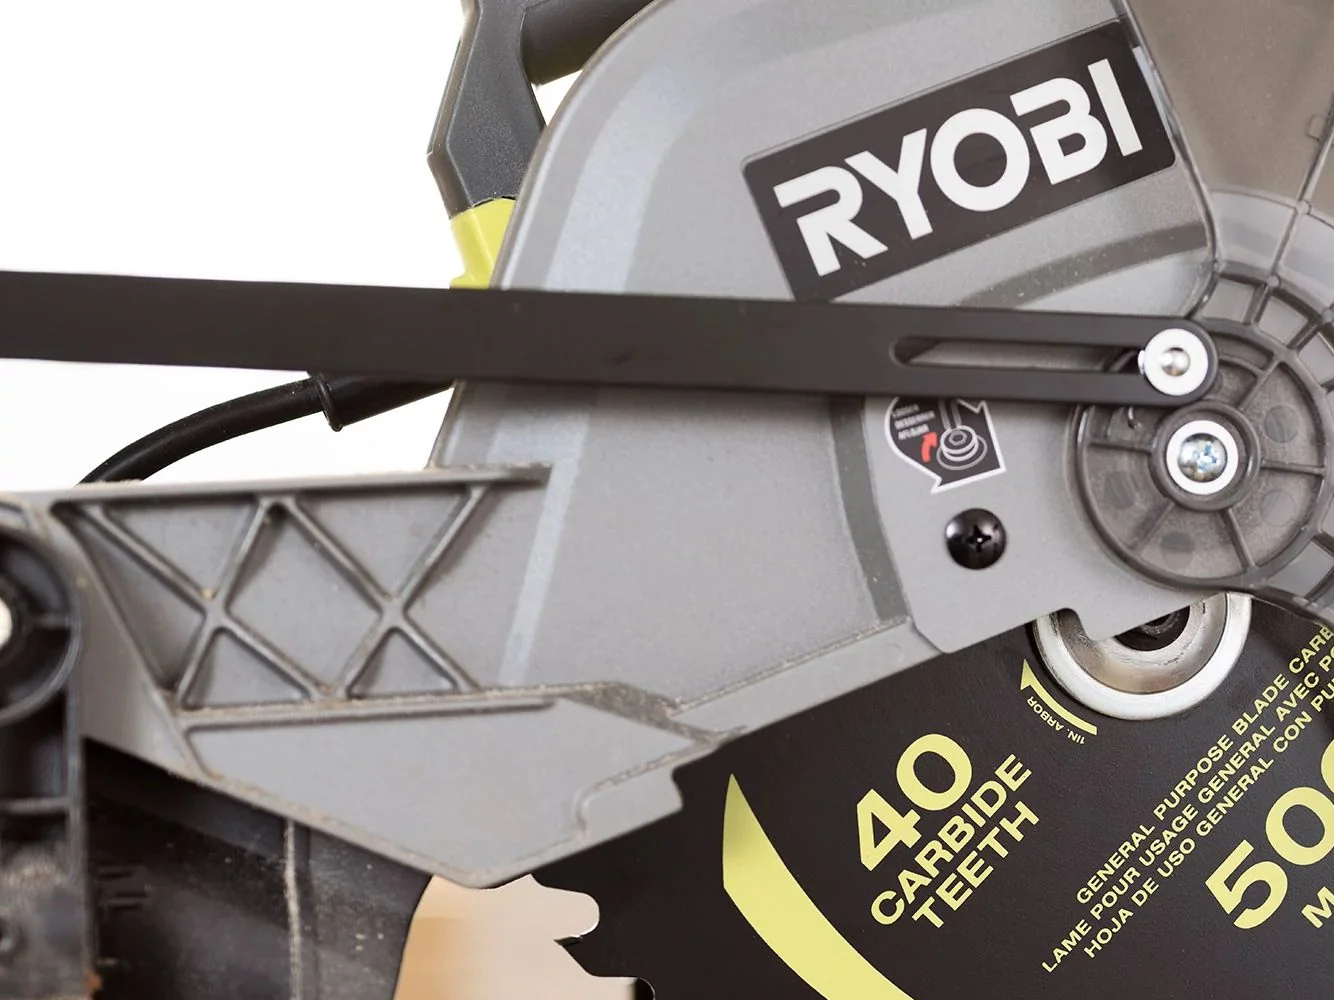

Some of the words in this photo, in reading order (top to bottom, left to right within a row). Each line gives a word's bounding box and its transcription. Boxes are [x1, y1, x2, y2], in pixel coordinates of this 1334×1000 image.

[773, 58, 1143, 277] RYOBI
[856, 733, 973, 872] 40
[1027, 696, 1065, 731] ARBOR
[1076, 824, 1156, 904] GENERAL
[1153, 734, 1235, 821] PURPOSE
[1232, 673, 1290, 736] BLADE
[871, 753, 1032, 925] CARBIDE
[911, 800, 1040, 929] TEETH
[1041, 919, 1092, 973] LAME
[1089, 866, 1141, 920] POUR
[1139, 803, 1199, 867] USAGE
[1197, 724, 1276, 804] GENERAL
[1275, 672, 1320, 722] AVEC
[1083, 907, 1134, 959] HOJA
[1131, 877, 1160, 907] DE
[1157, 838, 1196, 878] USO
[1196, 757, 1275, 837] GENERAL
[1273, 710, 1313, 753] CON
